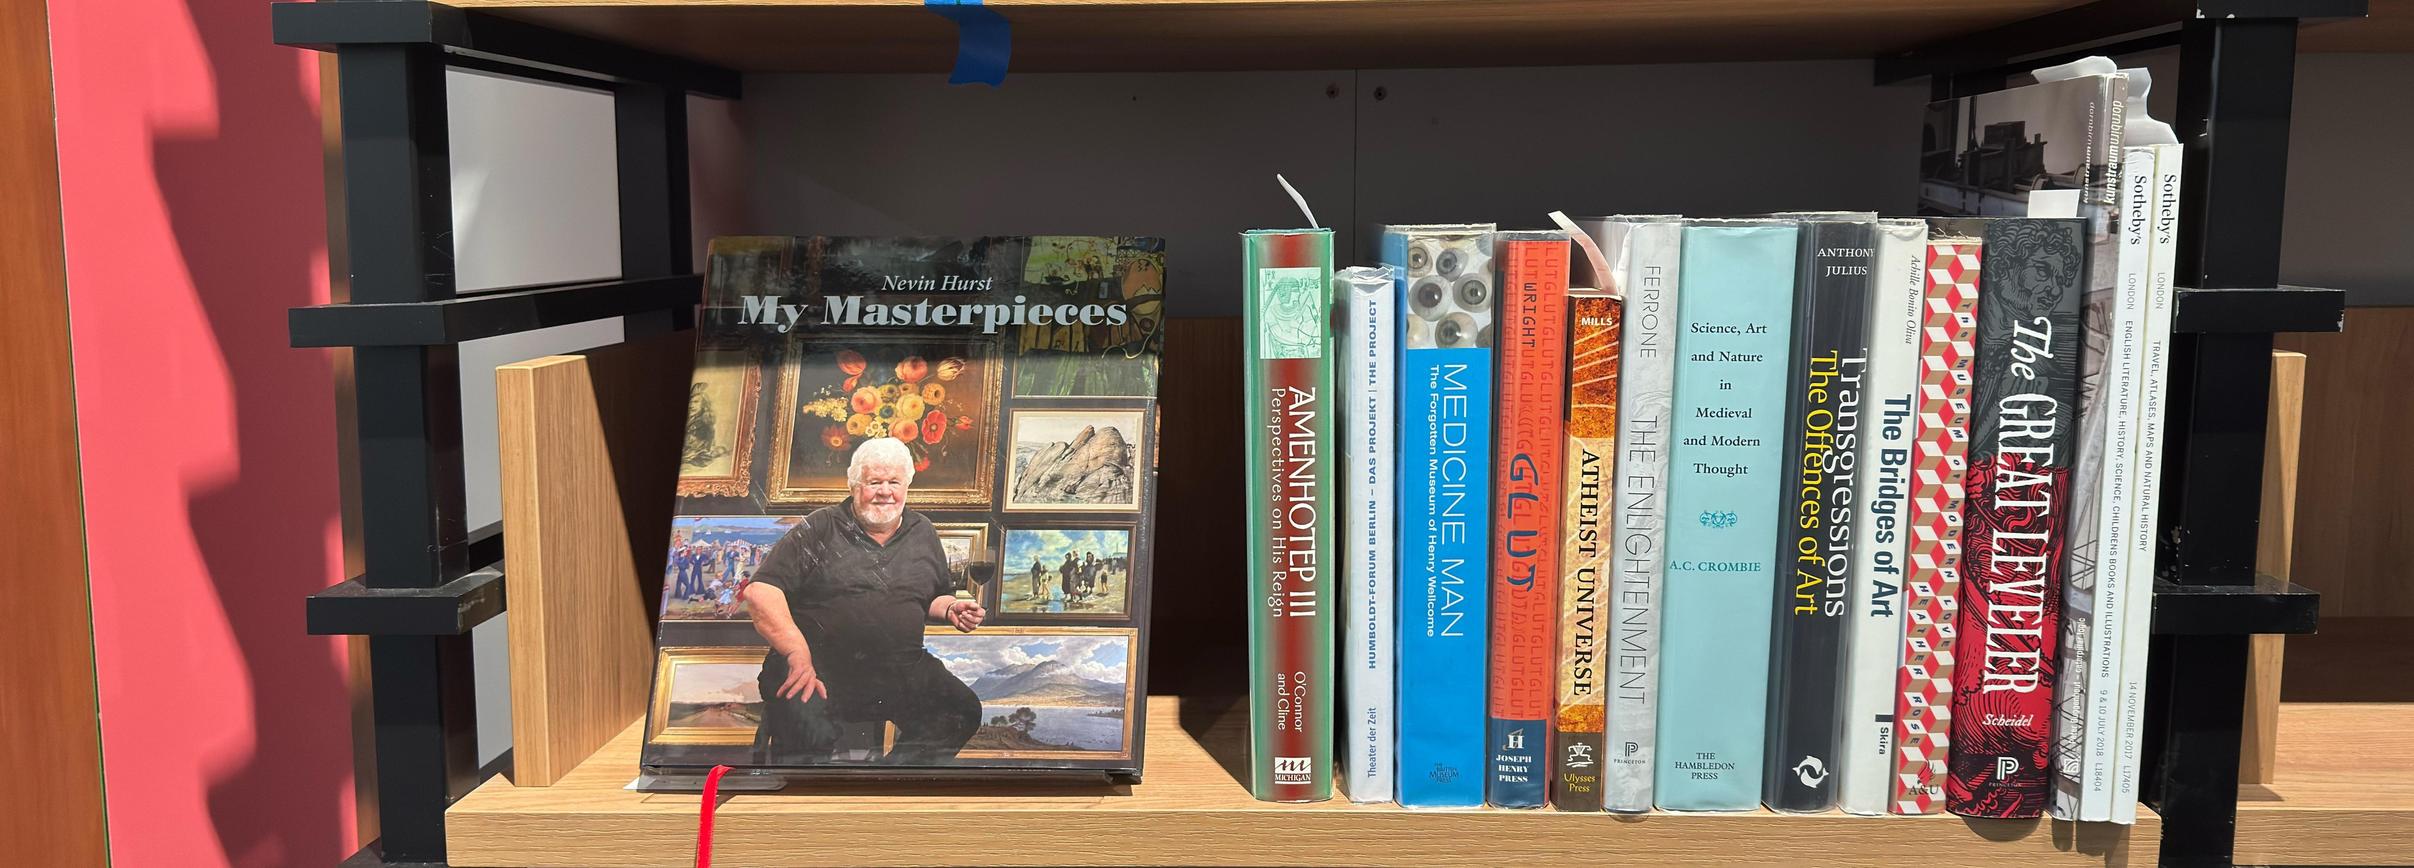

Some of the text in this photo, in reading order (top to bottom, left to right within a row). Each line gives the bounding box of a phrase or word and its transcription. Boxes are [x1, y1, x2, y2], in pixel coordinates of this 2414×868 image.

[2103, 145, 2120, 204] kunstraum
[2130, 174, 2147, 245] Sotheby's
[2157, 173, 2177, 245] Sotheby's
[881, 274, 994, 292] Nevin Hurst
[1825, 265, 1868, 277] JULIUS
[1911, 254, 1921, 286] Achille
[1907, 287, 1919, 318] Bonito
[2128, 273, 2136, 310] LONDON
[2156, 273, 2166, 309] LONDON
[737, 294, 1128, 335] My Masterpieces
[1521, 282, 1537, 348] WRIGHT
[1581, 317, 1613, 326] MILLS
[1640, 265, 1662, 358] FERRONE
[1690, 322, 1767, 336] Science, Art
[1368, 300, 1377, 360] PROJECT
[2123, 320, 2133, 360] ENGLISH
[1691, 351, 1763, 362] and Nature
[1368, 365, 1377, 386] THE
[1719, 378, 1732, 390] in
[1695, 407, 1752, 419] Medieval
[1951, 358, 1969, 439] MUSEUM
[1368, 396, 1377, 454] PROJEKT
[1683, 435, 1761, 446] and Modern
[2145, 422, 2155, 448] MAPS
[1368, 460, 1377, 484] DAS
[1693, 463, 1749, 478] Thought
[2145, 450, 2153, 470] AND
[1288, 385, 1317, 617] AMENHOTEP III
[1425, 365, 1440, 637] The Forgotten Museum of Henry Wellcome
[1441, 364, 1468, 637] MEDICINE MAN
[1794, 350, 1838, 616] The Offences of Art
[1822, 348, 1868, 618] Transgressions
[2141, 472, 2152, 511] NATURAL
[1267, 387, 1287, 617] Perspectives on His Reign
[1870, 393, 1912, 618] The Bridges of Art
[1982, 316, 2058, 695] The GREAT LEVELER
[1368, 498, 1376, 545] BERLIN
[1507, 452, 1539, 592] GLUT
[1944, 500, 1960, 579] MODERN
[2110, 505, 2120, 556] CHILDRENS
[2139, 512, 2149, 552] HISTORY
[1573, 448, 1600, 696] ATHEIST UNIVERSE
[1618, 415, 1657, 704] THE ENLIGHTENMENT
[1670, 560, 1761, 572] A.C. CROMBIE
[2107, 559, 2118, 588] BOOKS
[1368, 550, 1376, 669] HUMBOLDT-FORUM
[2106, 591, 2114, 609] AND
[1939, 599, 1952, 648] LOVE
[2101, 612, 2113, 678] ILLUSTRATIONS
[1910, 584, 1930, 745] HEATHER ROSE
[1277, 673, 1290, 731] and Cline
[1294, 672, 1306, 733] O'Connor
[2129, 681, 2137, 691] 14
[1982, 714, 2035, 727] Scheidel
[2097, 716, 2106, 736] JULY
[2125, 692, 2136, 738] NOVEMBER
[1367, 707, 1377, 779] Theater der Zeit
[1496, 754, 1532, 764] JOSEPH
[1695, 752, 1716, 760] THE
[1879, 727, 1889, 756] Skira
[2095, 737, 2104, 757] 2018
[2123, 740, 2133, 759] 2017
[1275, 773, 1312, 782] MICHIGAN
[1498, 764, 1529, 773] HENRY
[1498, 774, 1529, 783] PRESS
[1564, 773, 1595, 784] Ulysses
[1675, 761, 1735, 770] HAMBLEDON
[1691, 771, 1718, 780] PRESS
[1569, 783, 1590, 793] Press
[1908, 784, 1940, 796] A&U
